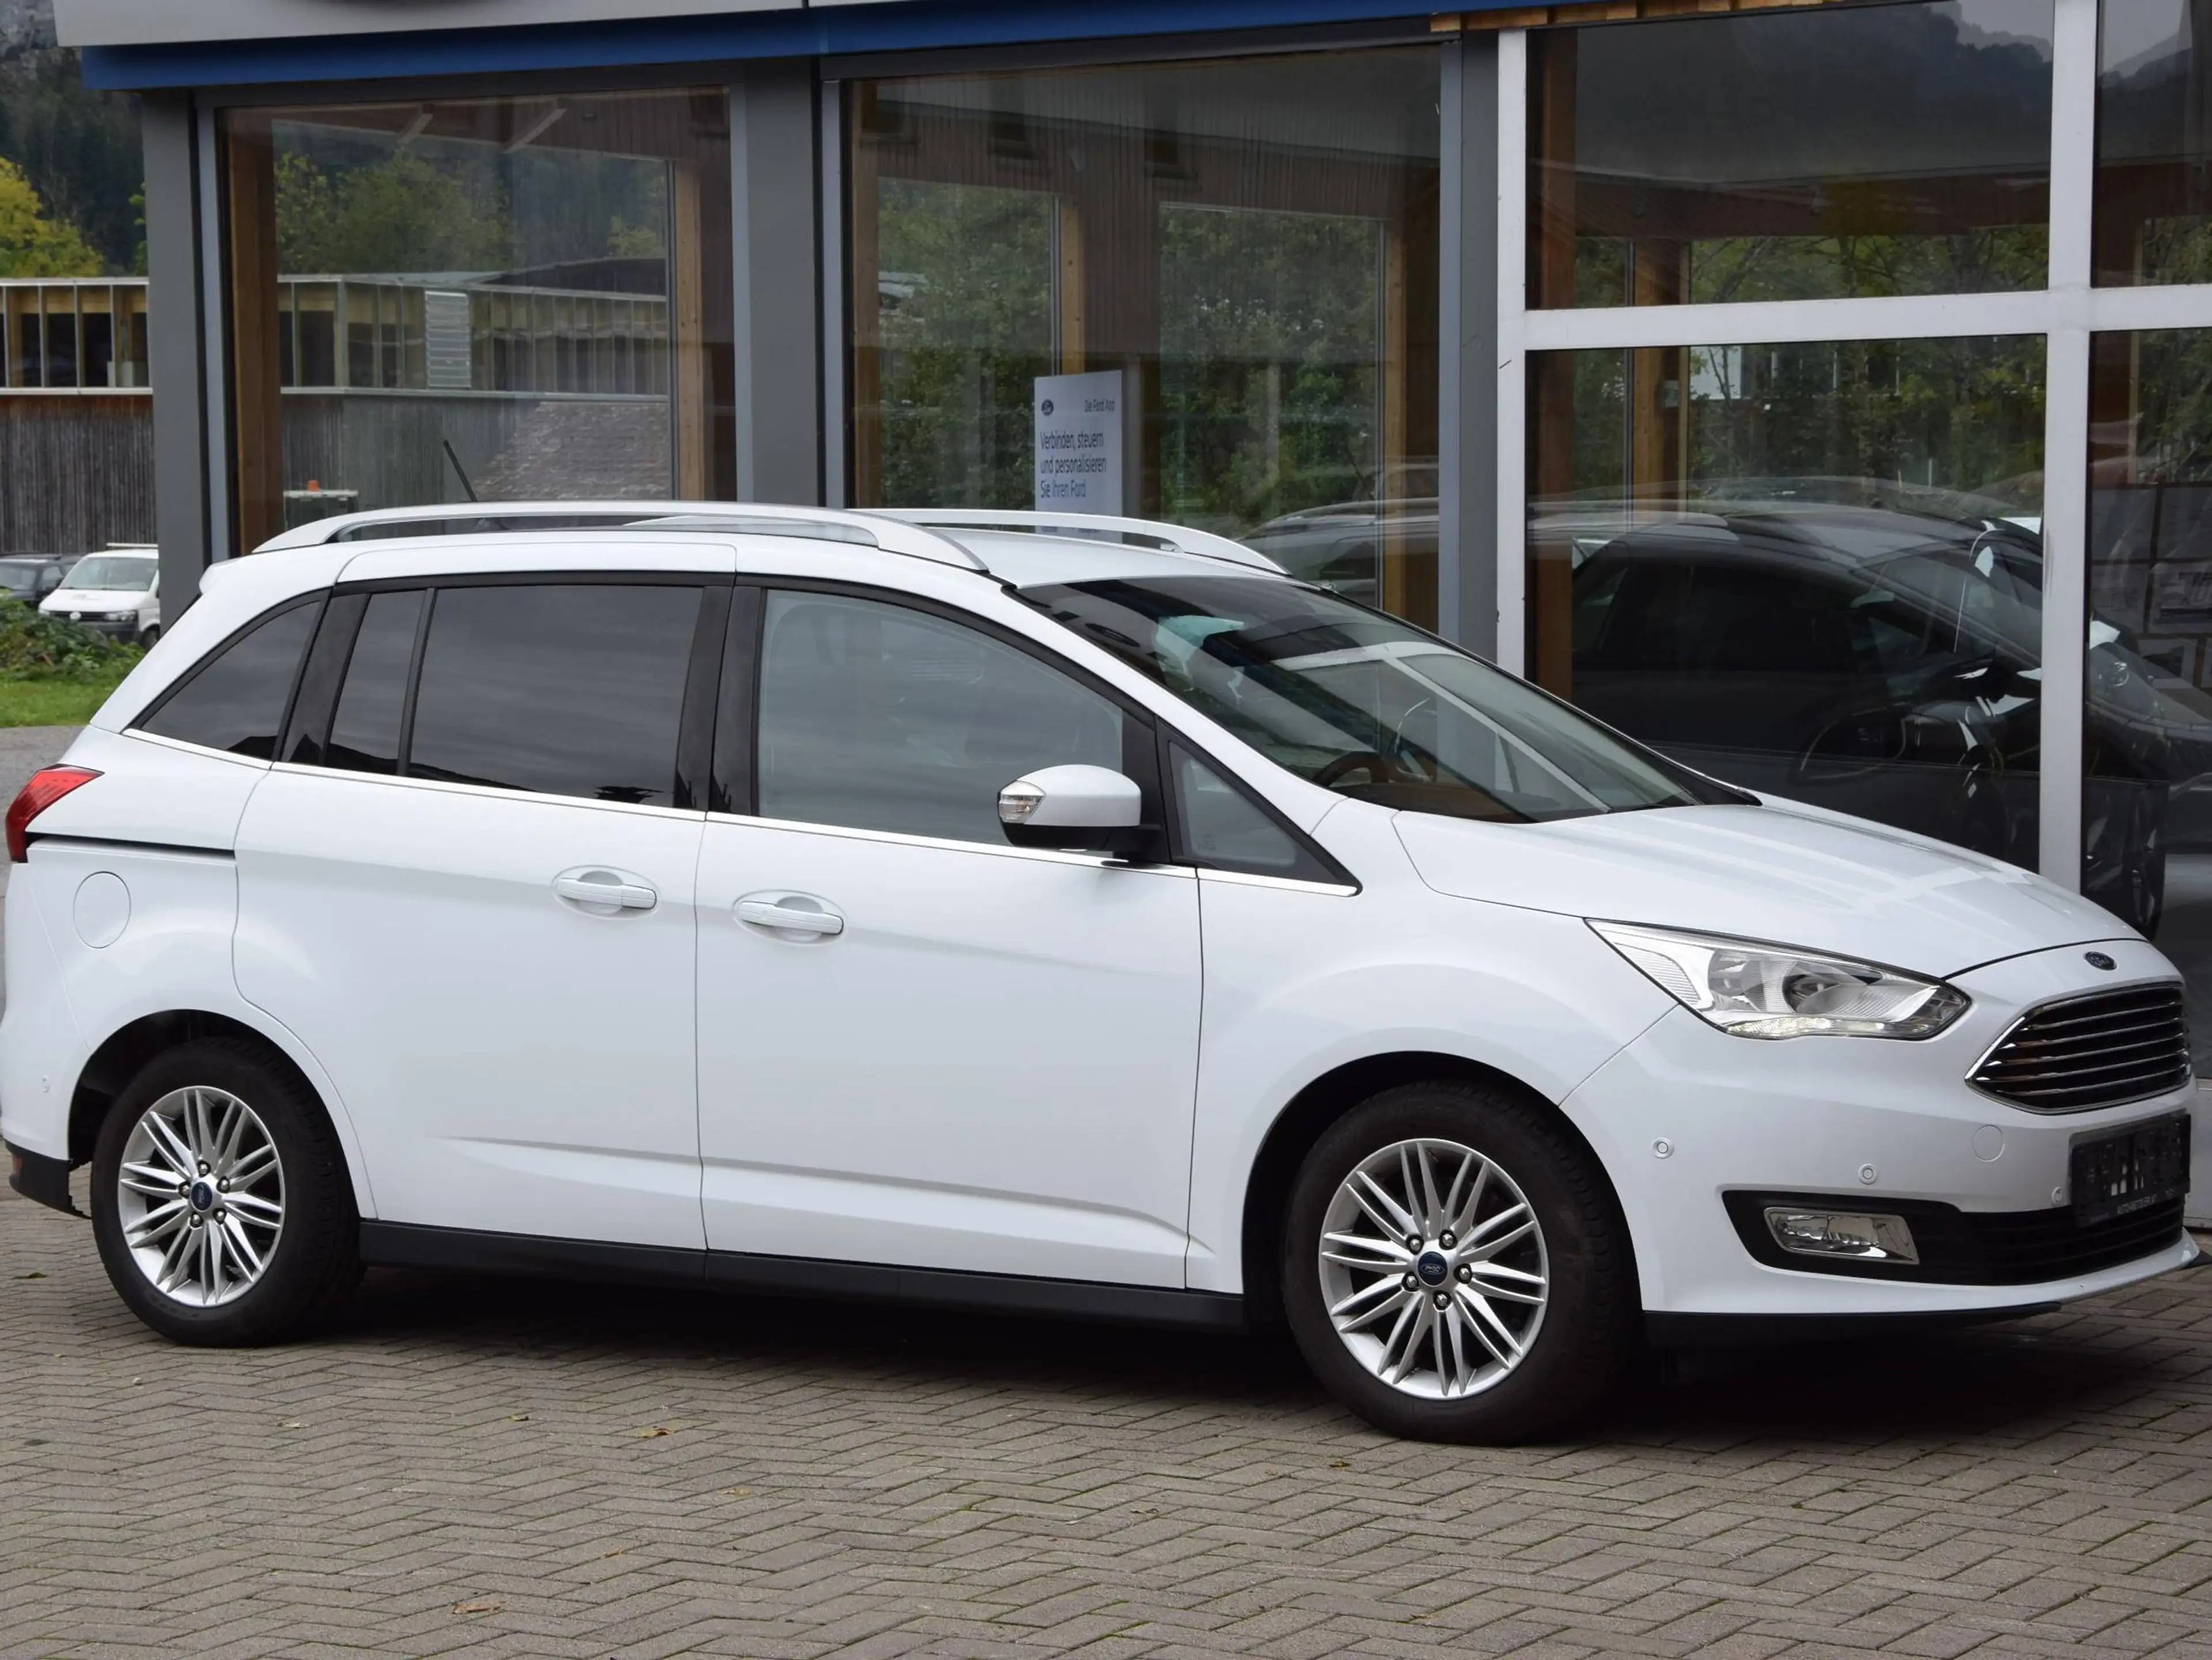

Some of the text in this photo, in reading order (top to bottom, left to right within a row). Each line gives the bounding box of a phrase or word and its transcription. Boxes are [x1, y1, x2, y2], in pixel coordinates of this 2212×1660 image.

[1040, 430, 1104, 451] Verbinden, steuern
[1040, 453, 1107, 477] und personalisieren
[1040, 478, 1086, 498] Sie Ihren Ford
